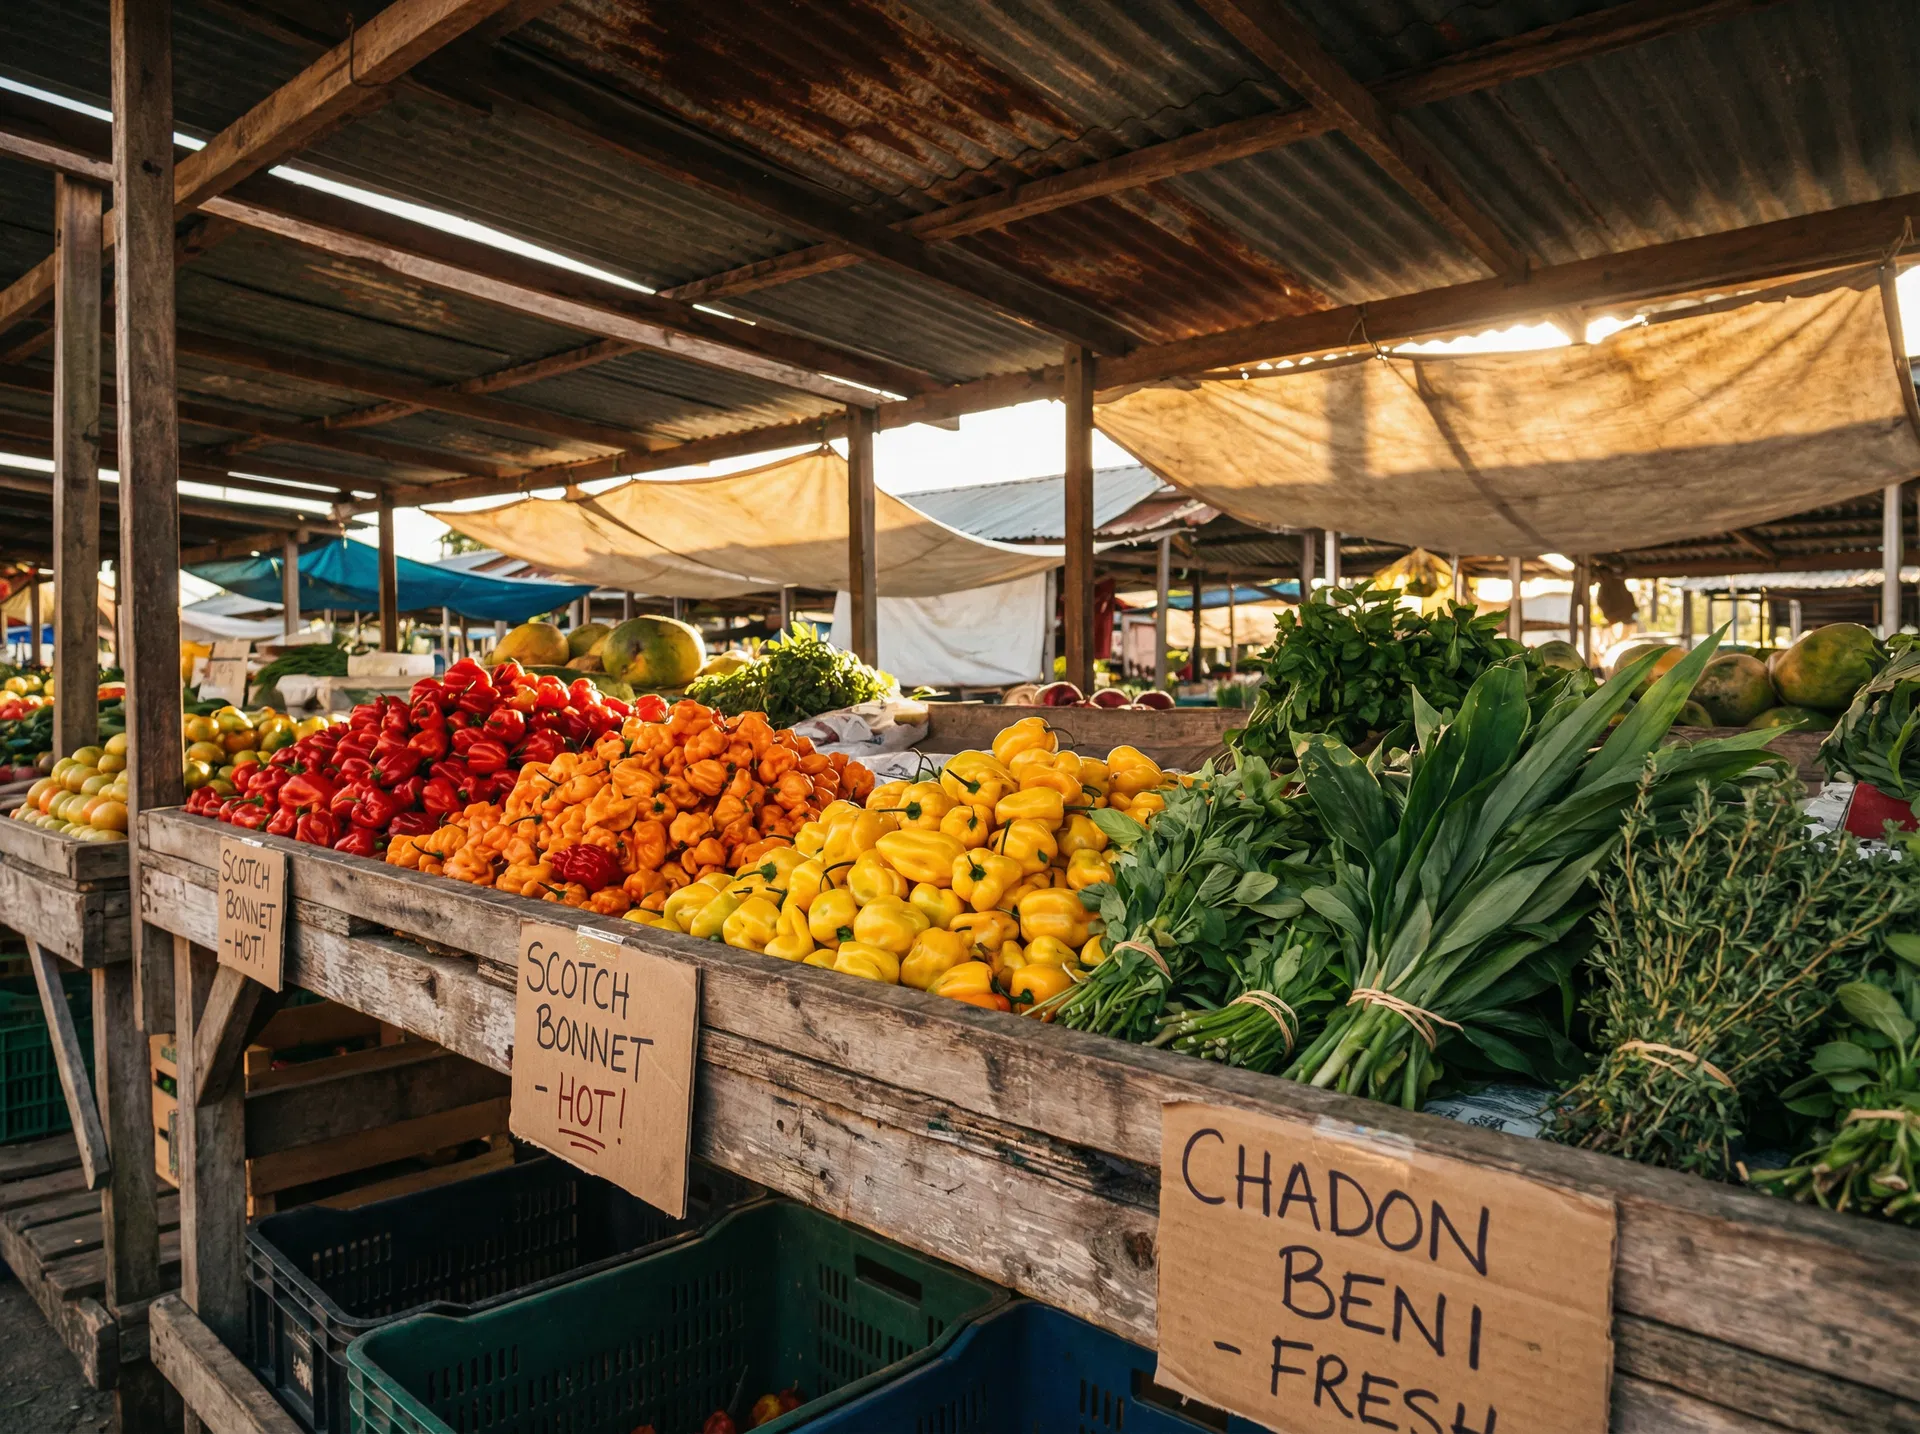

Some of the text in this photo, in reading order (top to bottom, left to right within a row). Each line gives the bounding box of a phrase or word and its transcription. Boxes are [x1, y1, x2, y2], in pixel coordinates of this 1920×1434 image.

[222, 849, 271, 893] SCOTCH
[226, 889, 276, 932] BONNET
[526, 941, 630, 1020] SCOTCH
[536, 1003, 654, 1083] BONNET
[558, 1072, 626, 1145] HOT!
[1182, 1128, 1489, 1276] CHADON
[1279, 1245, 1482, 1371] BENI
